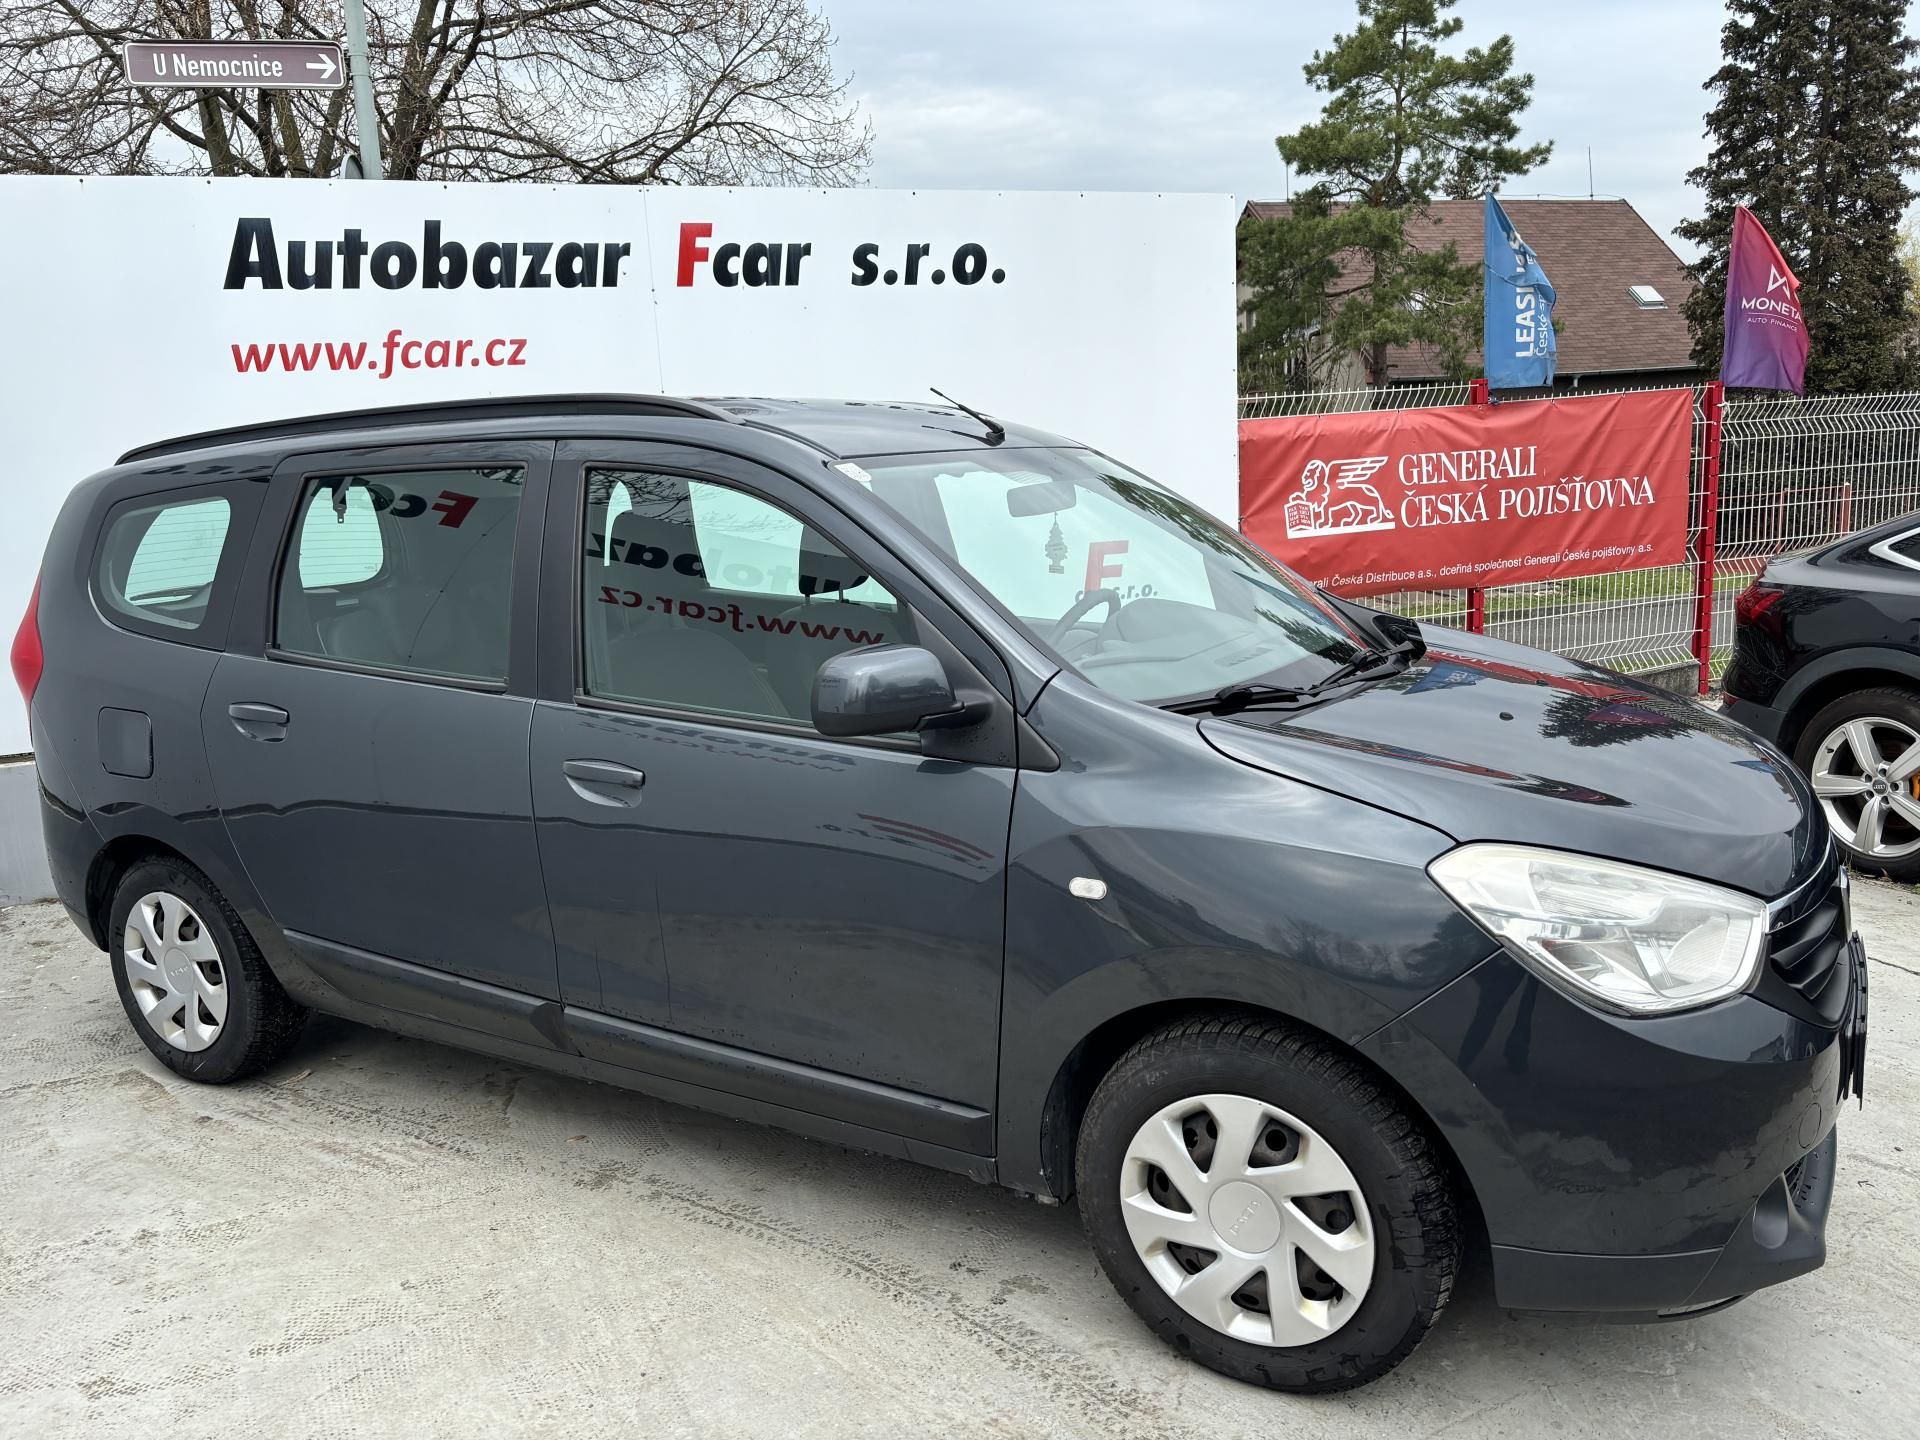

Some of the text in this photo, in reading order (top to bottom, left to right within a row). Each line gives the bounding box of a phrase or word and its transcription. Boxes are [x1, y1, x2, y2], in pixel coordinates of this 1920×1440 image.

[153, 53, 284, 78] U Nemocnice
[223, 217, 1006, 290] Autobazar Fcar s.r.o.
[1741, 296, 1803, 324] MONETA
[1770, 318, 1798, 332] FINANCE
[231, 329, 528, 380] www.fcar.cz
[1398, 445, 1538, 486] GENERALI
[1400, 475, 1656, 528] ČESKÁ POJIŠŤOVNA
[1309, 577, 1330, 588] rali
[1331, 573, 1363, 587] Česká
[1365, 570, 1415, 584] Distribuce
[1439, 561, 1472, 577] dceřiná
[1474, 557, 1522, 573] společnost
[1524, 552, 1561, 566] Generali
[1562, 549, 1591, 562] České
[1638, 543, 1653, 553] a.s.
